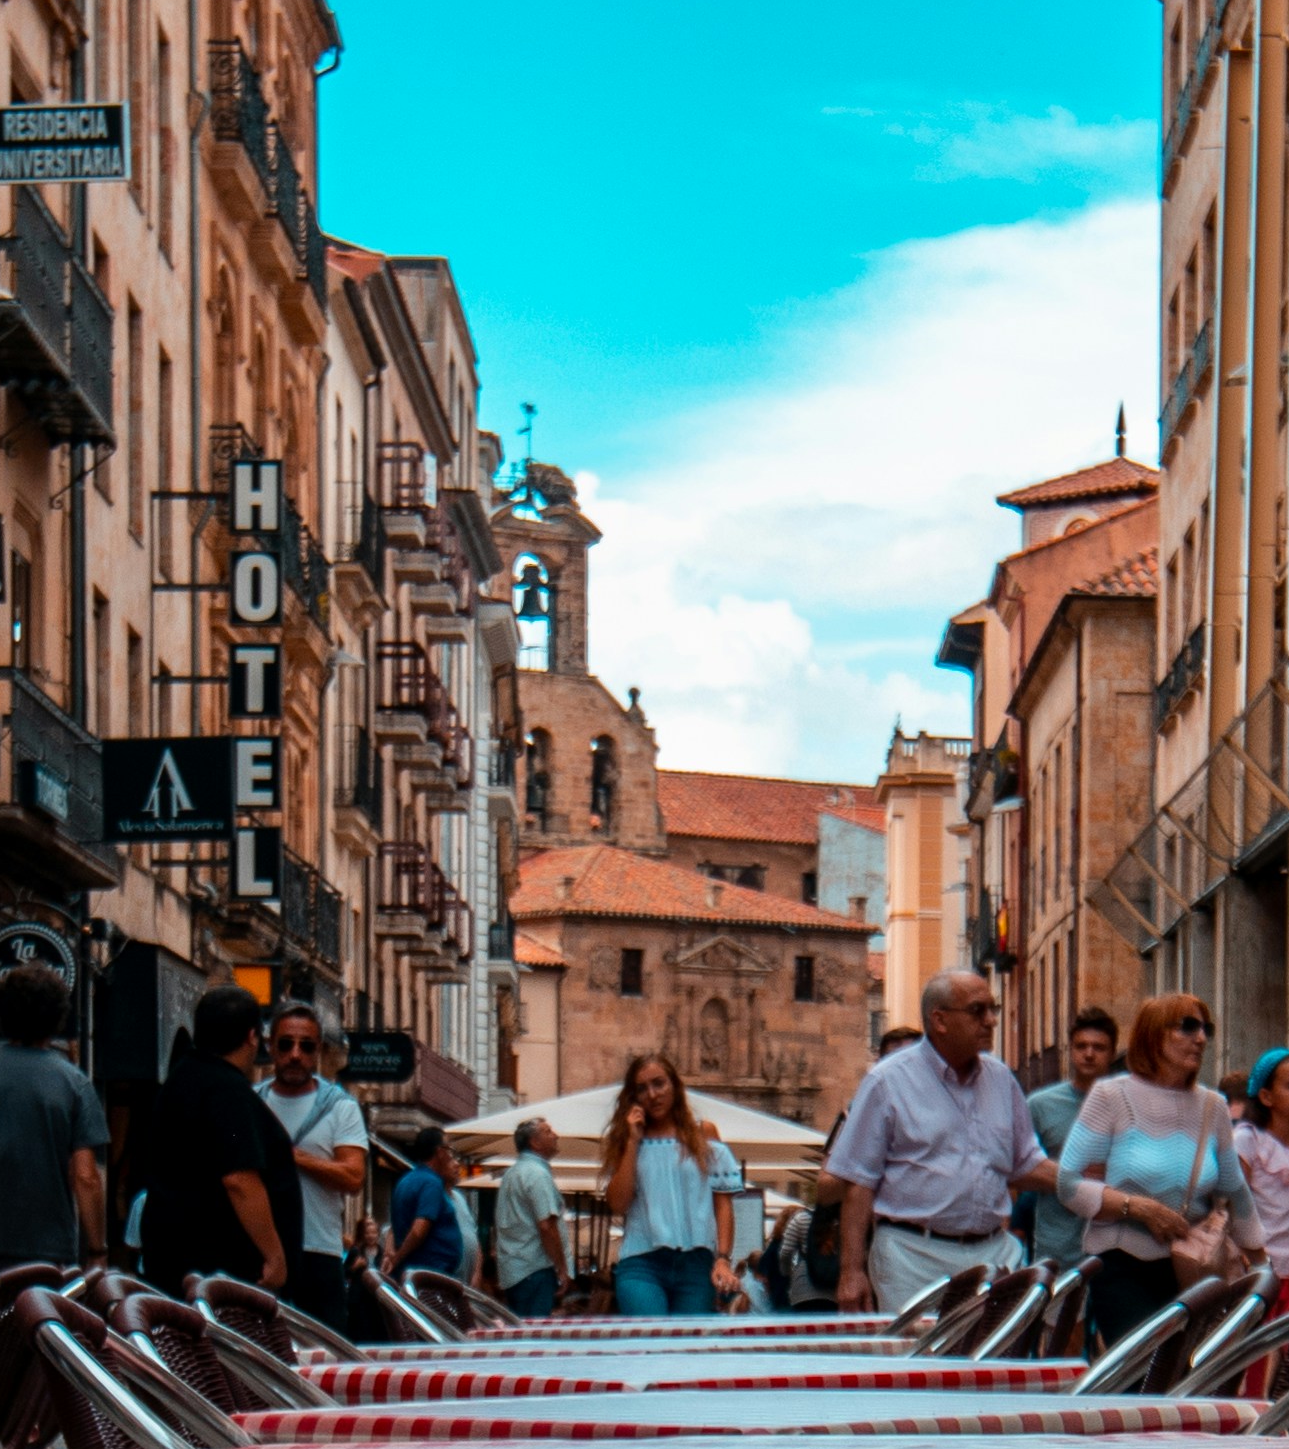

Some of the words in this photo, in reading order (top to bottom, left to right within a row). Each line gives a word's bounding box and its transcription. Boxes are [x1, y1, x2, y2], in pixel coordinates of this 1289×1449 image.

[2, 109, 109, 142] RESIDENCIA
[233, 463, 278, 897] HOTEL
[10, 937, 38, 964] La
